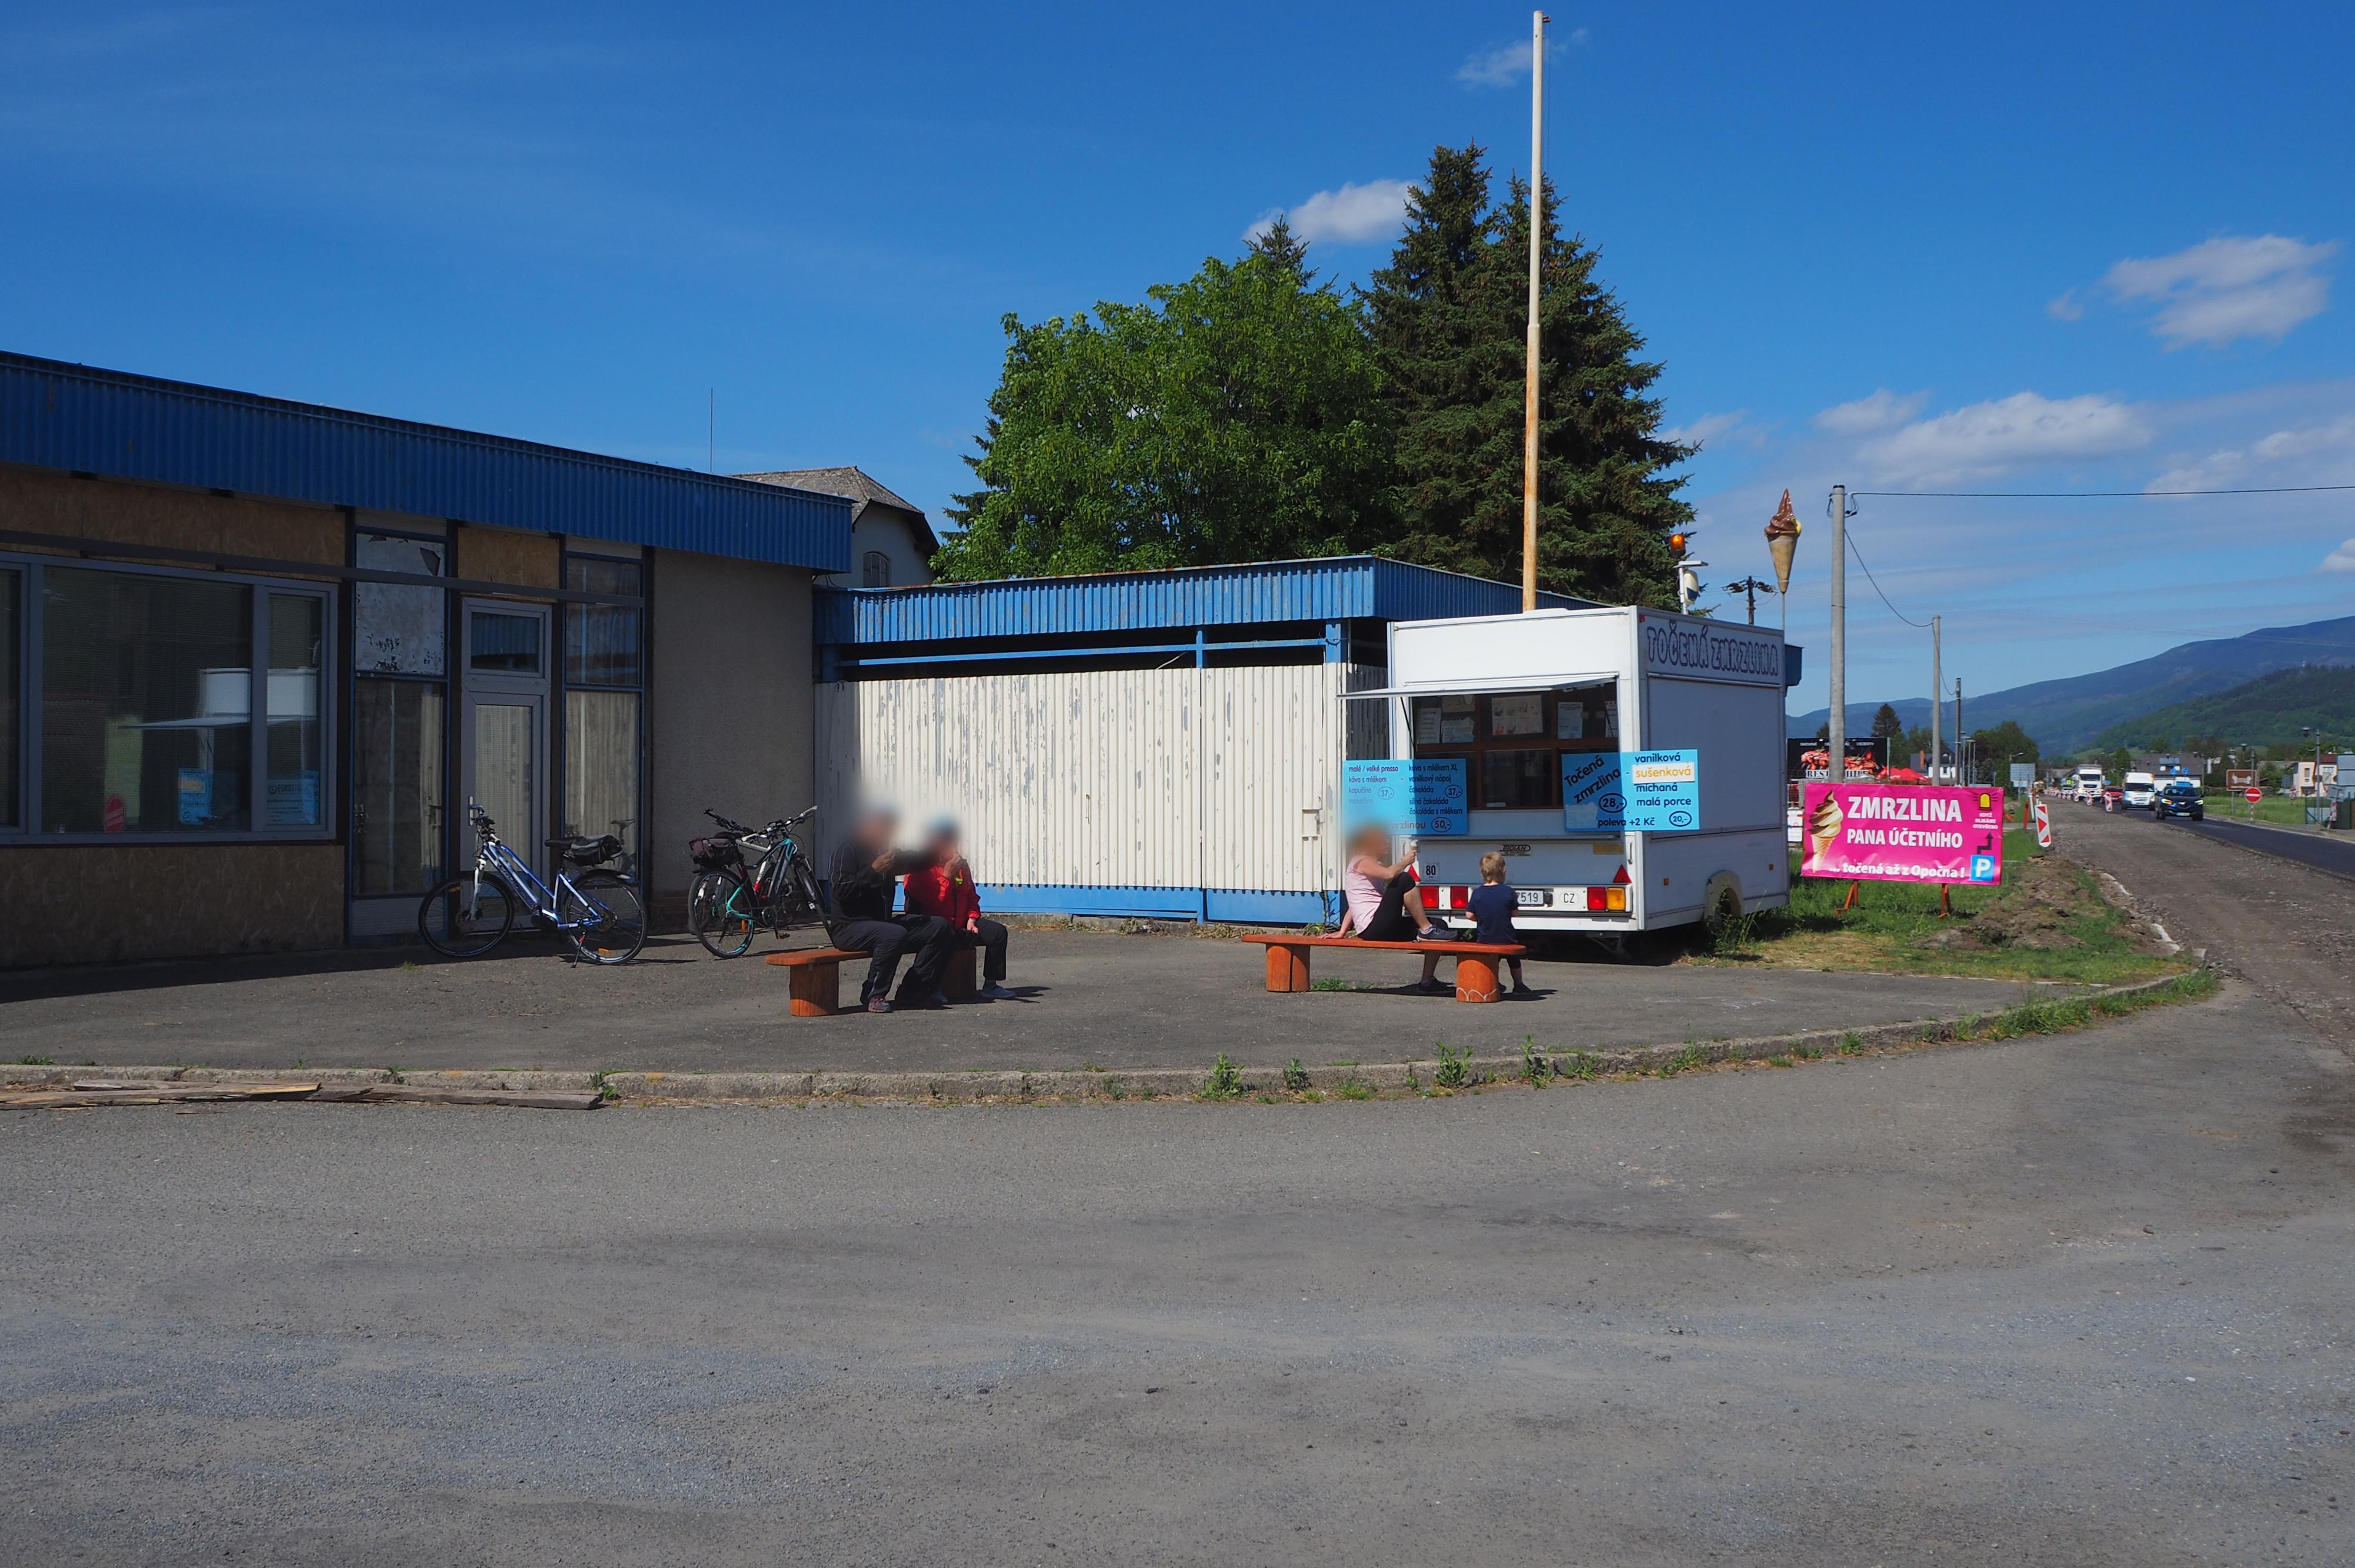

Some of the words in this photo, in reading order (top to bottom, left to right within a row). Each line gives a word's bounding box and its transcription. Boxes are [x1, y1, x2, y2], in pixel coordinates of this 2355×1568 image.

[1647, 619, 1708, 668] TOČENÁ
[1711, 637, 1778, 676] ZMRZLINA
[1634, 752, 1681, 763] vanilková
[1564, 755, 1604, 787] Točená
[1636, 766, 1691, 778] sušenková
[1435, 774, 1451, 783] nápoj
[1574, 768, 1621, 804] zmrzlina
[1423, 797, 1448, 805] čokoláda
[1637, 797, 1660, 805] malá
[1664, 798, 1691, 808] porce
[1847, 796, 1962, 822] ZMRZLINA
[1390, 820, 1425, 829] mrzlinou
[1598, 817, 1626, 828] poleva
[1644, 817, 1655, 826] Kč
[1847, 828, 1886, 845] PANA
[1889, 827, 1963, 848] ÚČETNÍHO
[1426, 865, 1436, 876] 80
[1843, 863, 1883, 874] točená
[1885, 864, 1900, 874] až
[1902, 867, 1909, 875] z
[1911, 864, 1958, 879] Opočna
[1975, 858, 1991, 877] P
[1564, 893, 1575, 903] CZ
